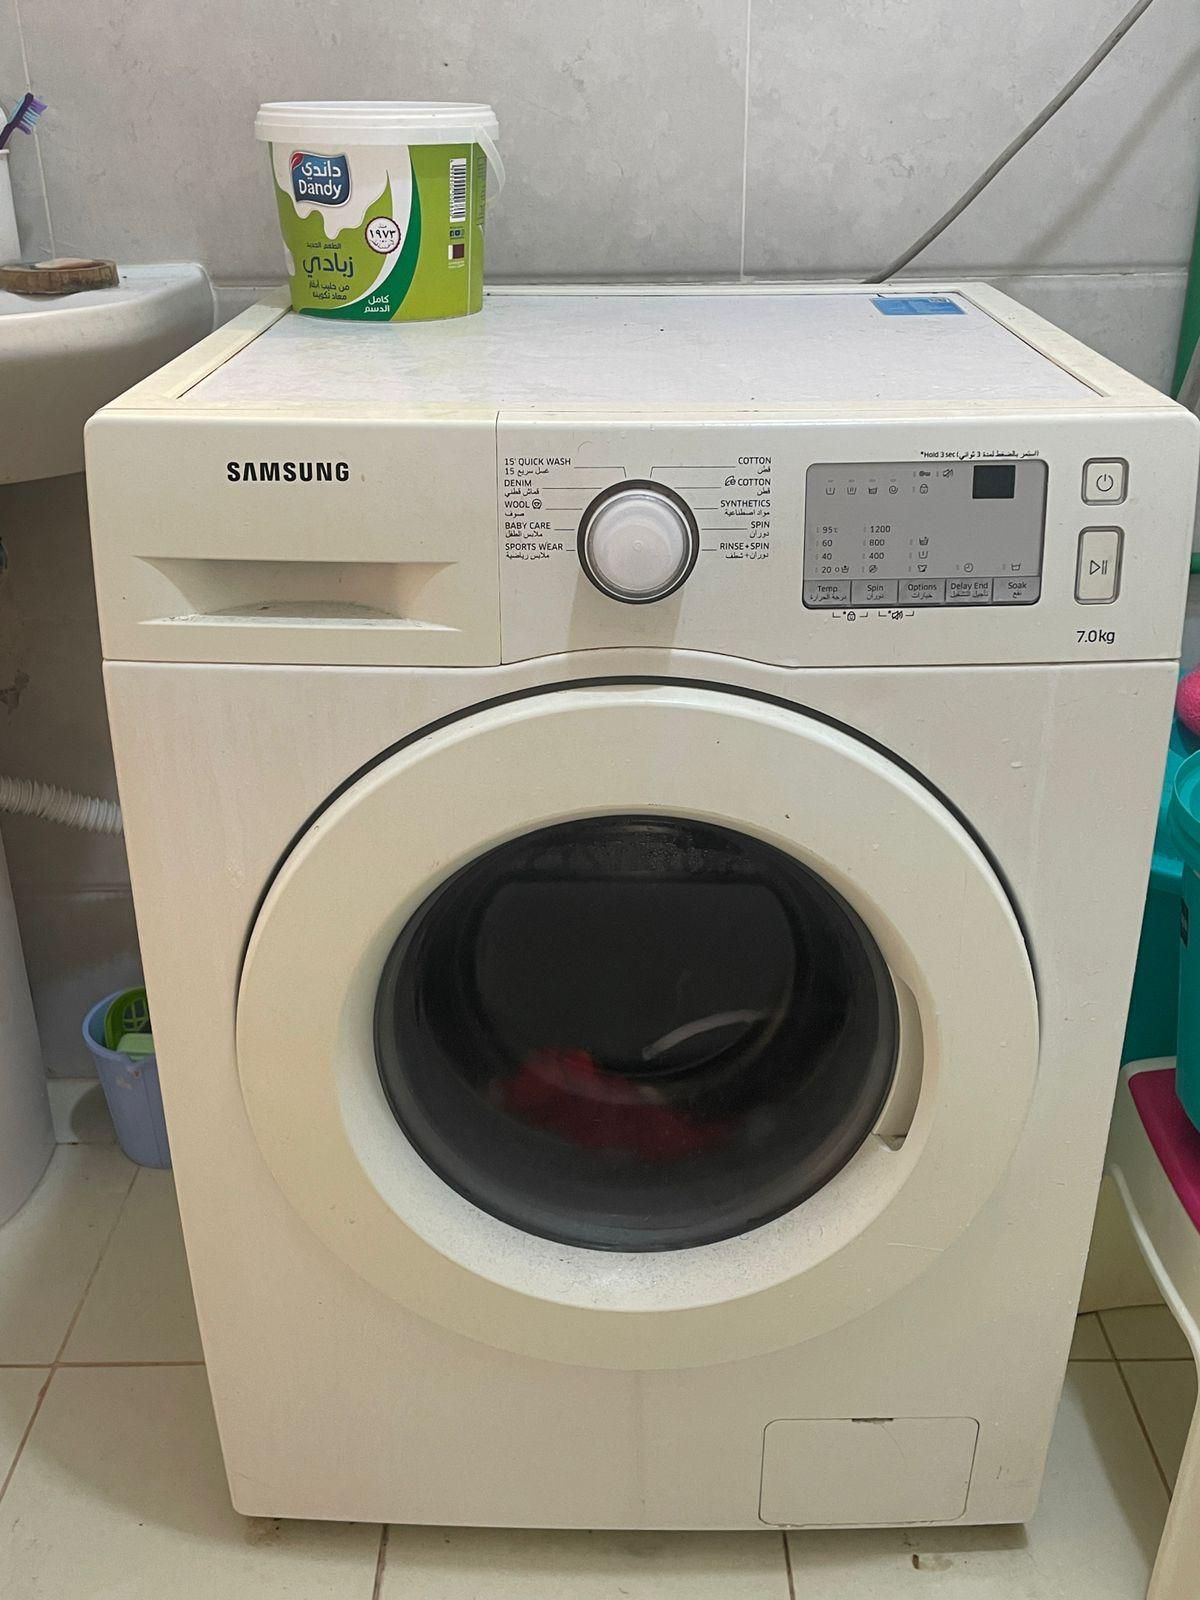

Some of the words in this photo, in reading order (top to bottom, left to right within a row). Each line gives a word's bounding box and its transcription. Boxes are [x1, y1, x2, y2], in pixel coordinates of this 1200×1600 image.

[301, 160, 341, 180] داندي
[298, 179, 342, 200] Dandy
[302, 252, 354, 278] زبادي
[338, 284, 350, 292] من
[367, 295, 390, 305] كامل
[363, 305, 390, 313] الدسم
[518, 457, 544, 467] QUICK
[546, 457, 571, 466] WASH
[738, 456, 772, 465] COTTON
[226, 461, 350, 482] SAMSUNG
[504, 467, 515, 475] 15
[504, 479, 532, 487] DENIM
[737, 478, 771, 487] COTTON
[504, 500, 530, 509] WOOL
[720, 499, 771, 508] SYNTHETICS
[504, 521, 528, 530] BABY
[529, 521, 551, 530] CARE
[750, 520, 770, 529] SPIN
[870, 525, 891, 533] 1200
[504, 542, 537, 551] SPORTS
[538, 542, 563, 551] WEAR
[822, 539, 833, 547] 60
[869, 538, 885, 547] 800
[821, 552, 833, 560] 40
[868, 552, 885, 560] 400
[821, 566, 832, 574] 20
[817, 585, 838, 593] Temp
[866, 584, 884, 593] Spin
[907, 583, 937, 592] Options
[950, 582, 972, 591] Delay
[1007, 581, 1027, 590] Soak
